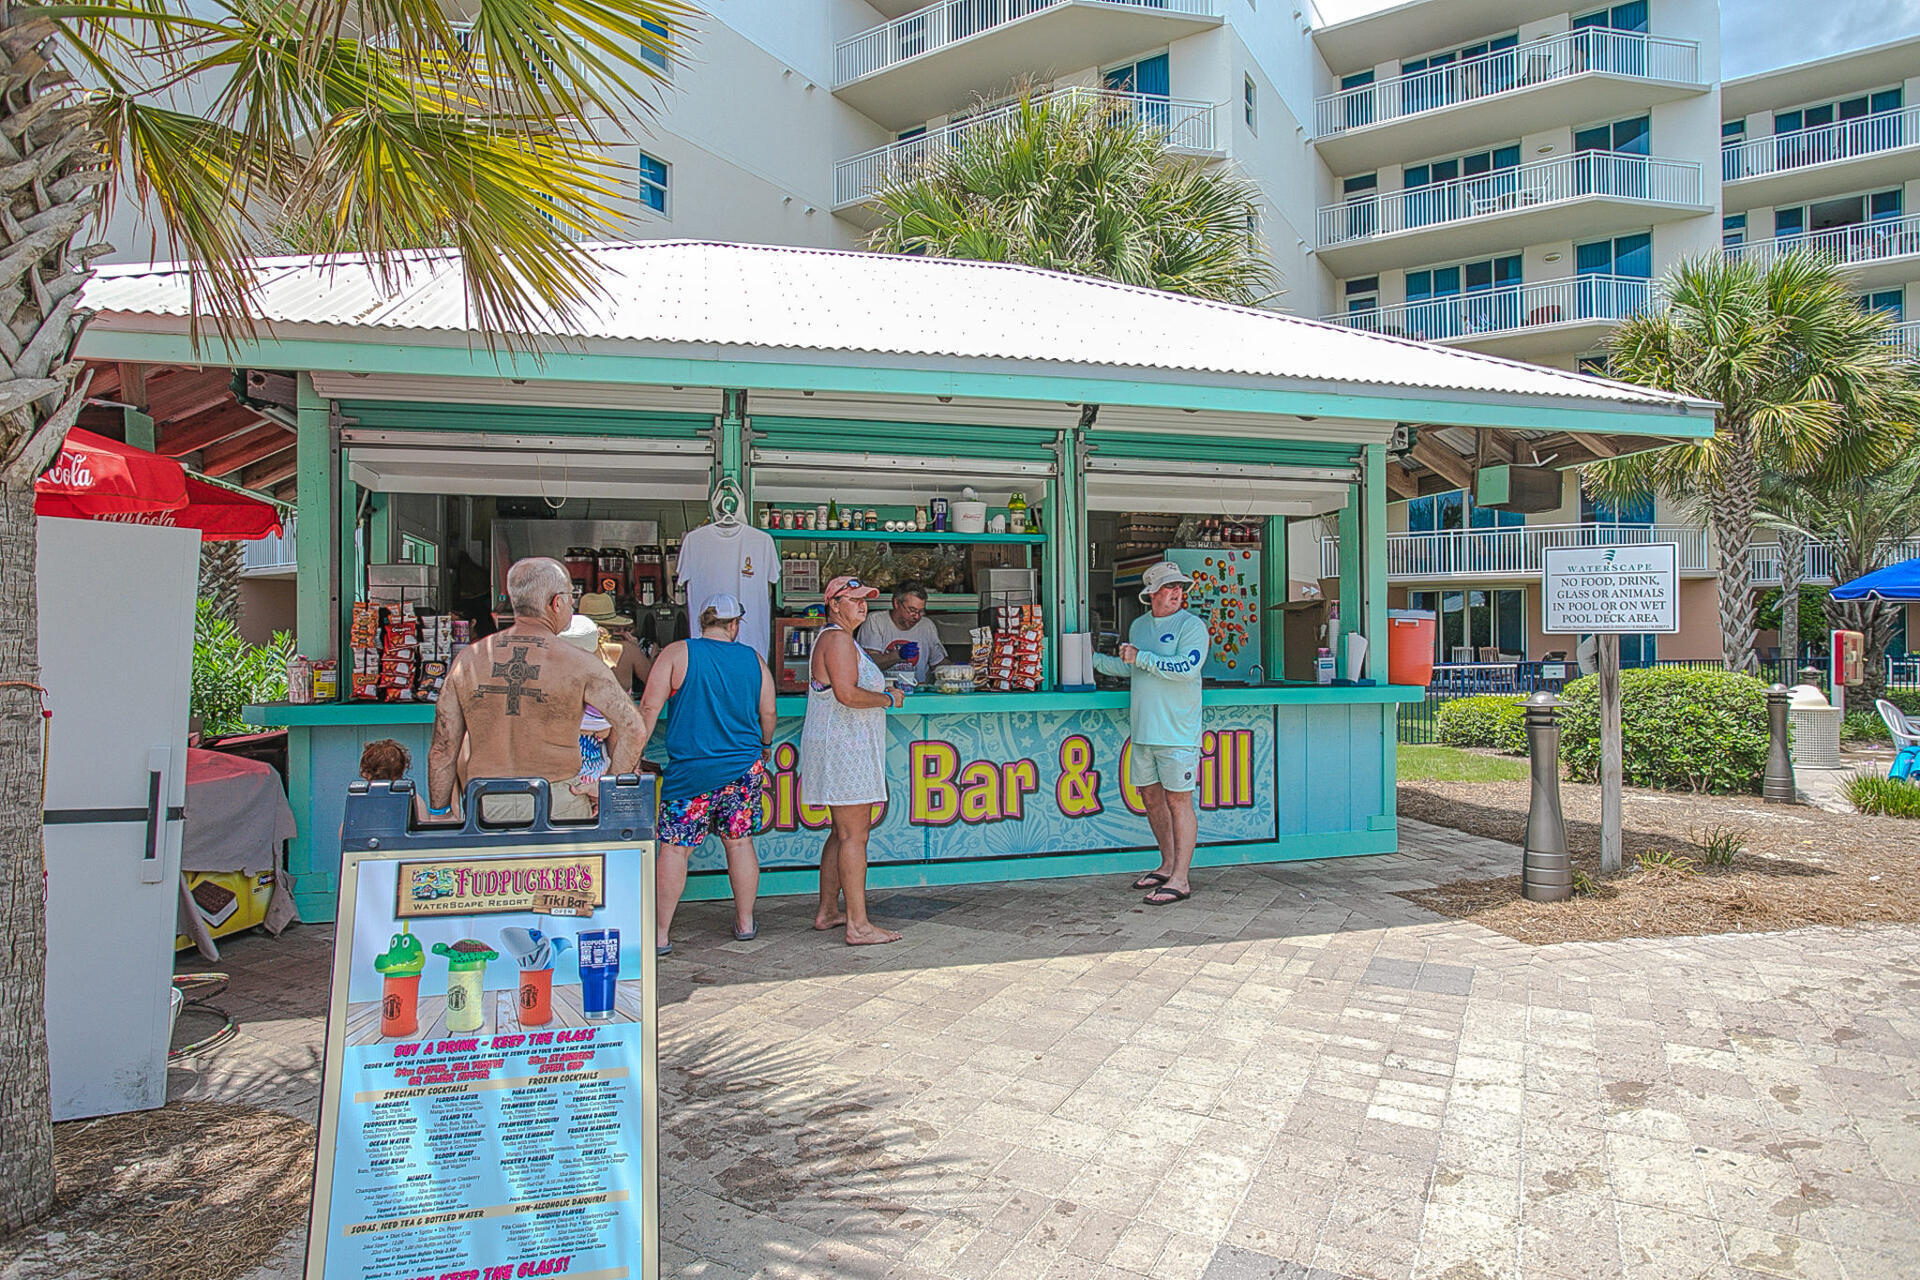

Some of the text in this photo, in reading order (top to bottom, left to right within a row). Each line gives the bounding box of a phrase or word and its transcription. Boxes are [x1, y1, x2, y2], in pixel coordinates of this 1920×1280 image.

[1567, 563, 1652, 573] WATERSCAPE
[1561, 578, 1578, 588] NO
[1581, 577, 1615, 588] FOOD,
[1557, 588, 1665, 600] GLASS OR ANIMALS
[1553, 601, 1667, 612] IN POOL OR ON WET
[1562, 612, 1659, 623] POOL DECK AREA
[910, 738, 1041, 827] Bar
[1055, 734, 1105, 818] &
[455, 865, 593, 898] FUDPUCKER'S
[488, 898, 530, 908] RESORT
[543, 893, 588, 909] Tiki Bar
[394, 1043, 420, 1058] BUY
[423, 1041, 435, 1056] A
[437, 1038, 480, 1054] DRINK
[490, 1035, 526, 1050] KEEP
[528, 1031, 554, 1047] THE
[556, 1028, 597, 1045] GLASS
[528, 1071, 599, 1086] FROZEN COCKTAILS
[383, 1083, 469, 1100] SPECIALTY COCKTAILS
[514, 1194, 607, 1213] NON-ALCOHOLIC DAIQUIRIS
[350, 1223, 379, 1235] SODAS,
[380, 1220, 399, 1231] ICED
[400, 1218, 416, 1229] TEA
[424, 1213, 456, 1226] BOTTLED
[457, 1209, 485, 1222] WATER
[517, 1255, 572, 1278] GLASS!
